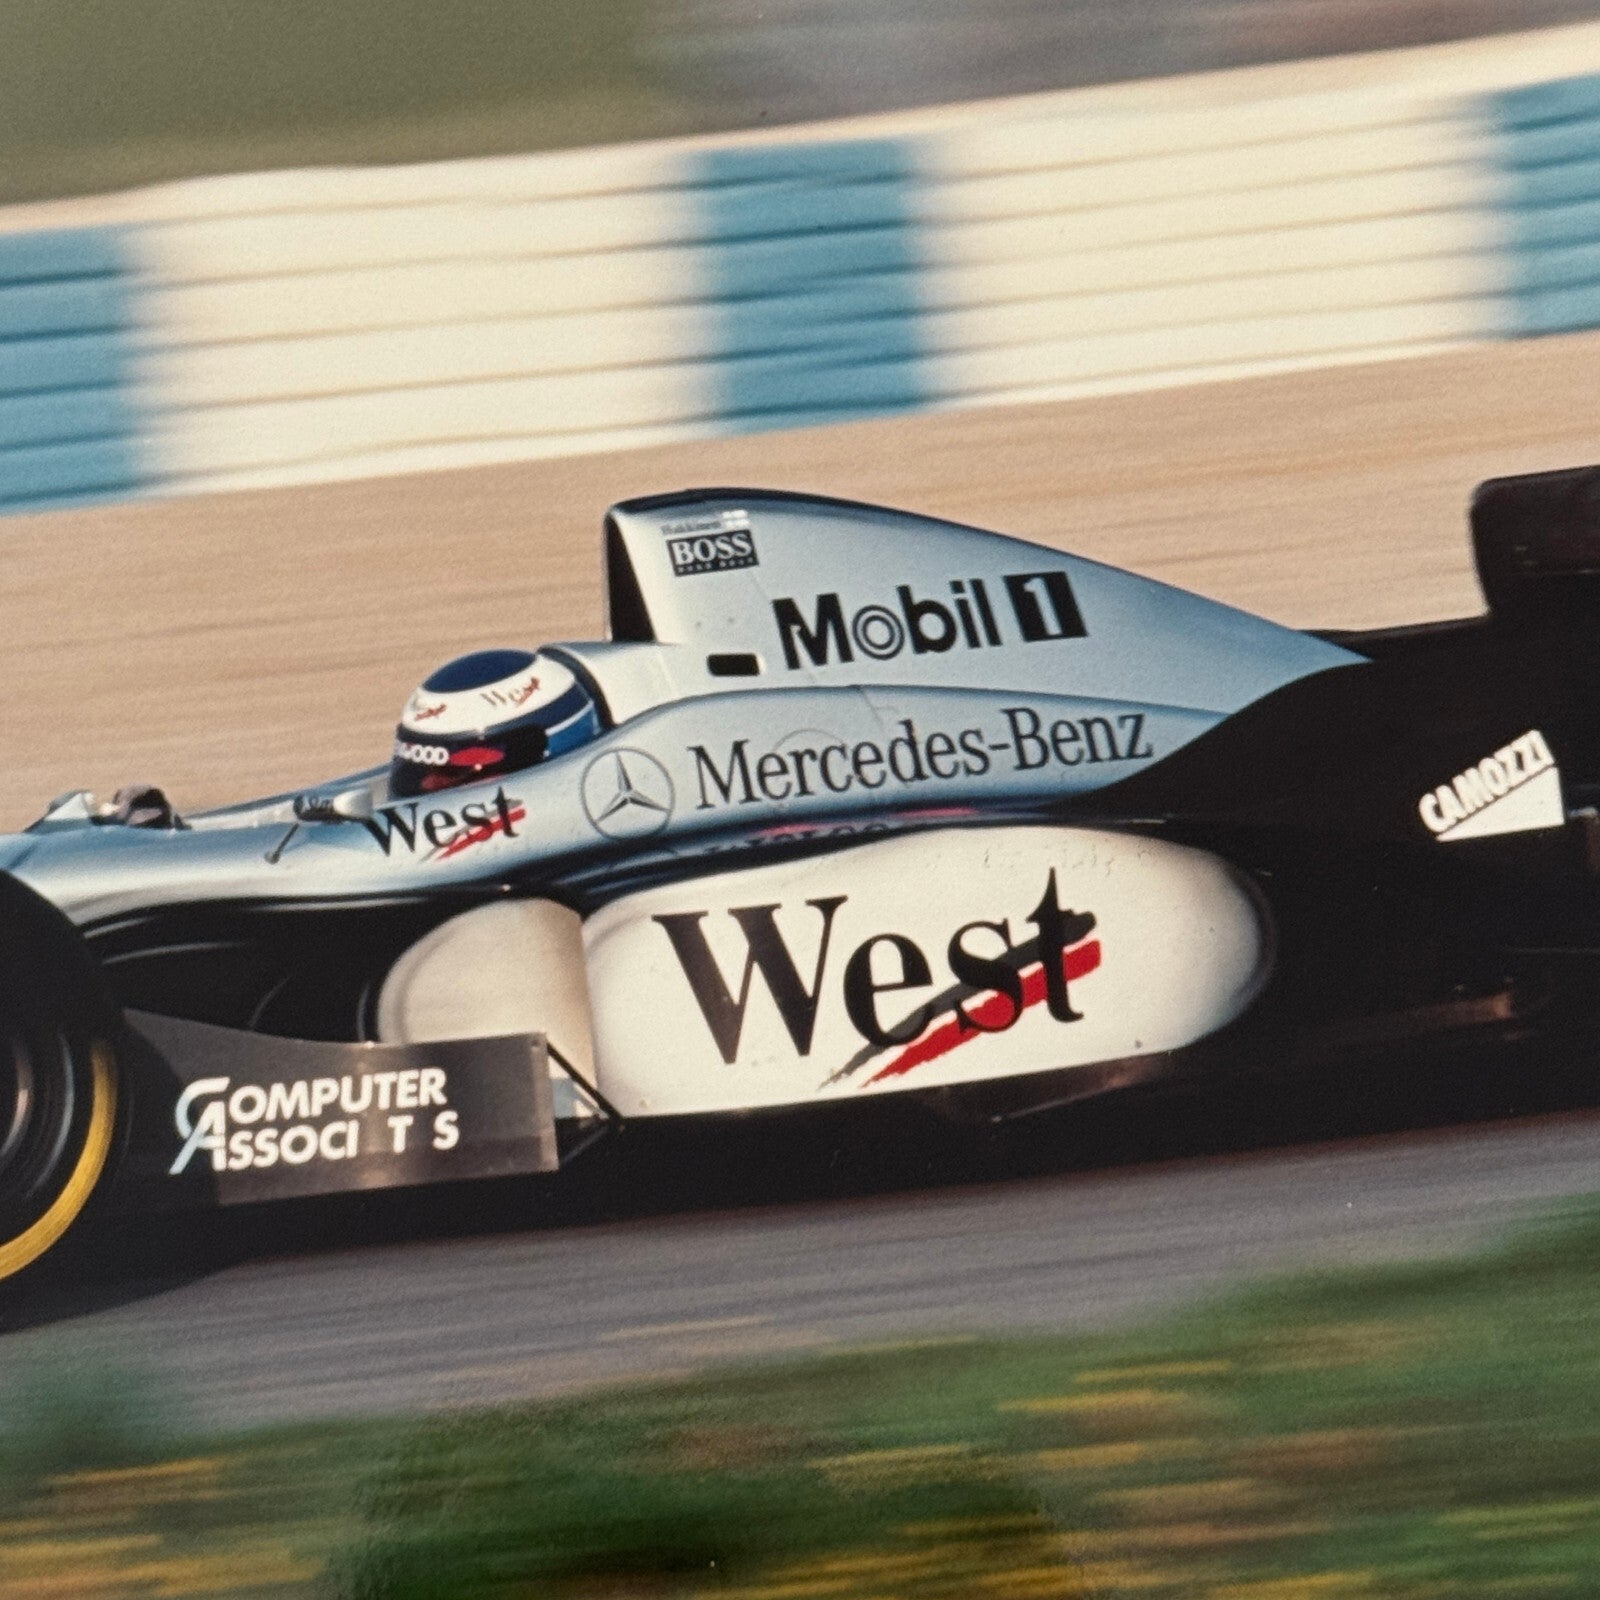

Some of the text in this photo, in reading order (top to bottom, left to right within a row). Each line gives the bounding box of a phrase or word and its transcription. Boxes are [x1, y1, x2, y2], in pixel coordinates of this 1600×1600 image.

[671, 532, 752, 566] BOSS
[772, 577, 1063, 670] Mobil 1
[687, 707, 1153, 809] Mercedes-Benz
[1418, 729, 1555, 833] CAMOZZI
[364, 785, 520, 857] West
[652, 867, 1084, 1065] West
[175, 1067, 448, 1139] COMPUTER
